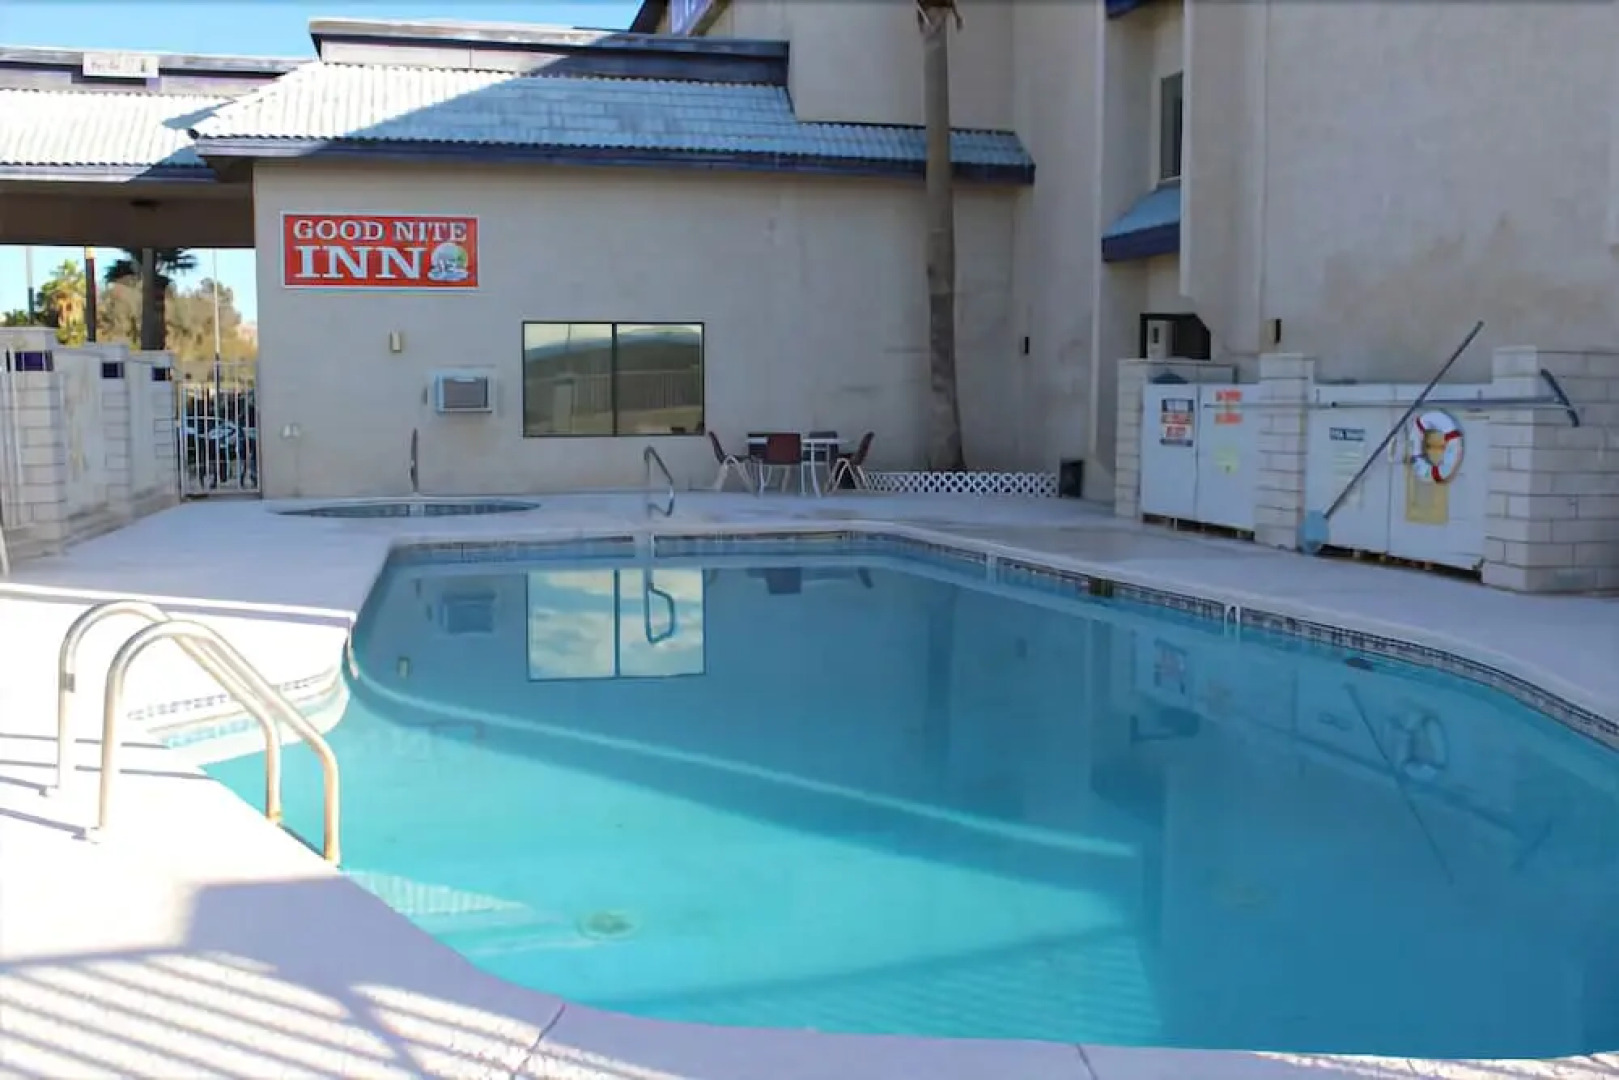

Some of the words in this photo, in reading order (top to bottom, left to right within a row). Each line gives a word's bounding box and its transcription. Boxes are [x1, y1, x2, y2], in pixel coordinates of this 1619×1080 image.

[293, 219, 384, 241] GOOD
[393, 221, 467, 242] NITE
[294, 245, 428, 279] INN
